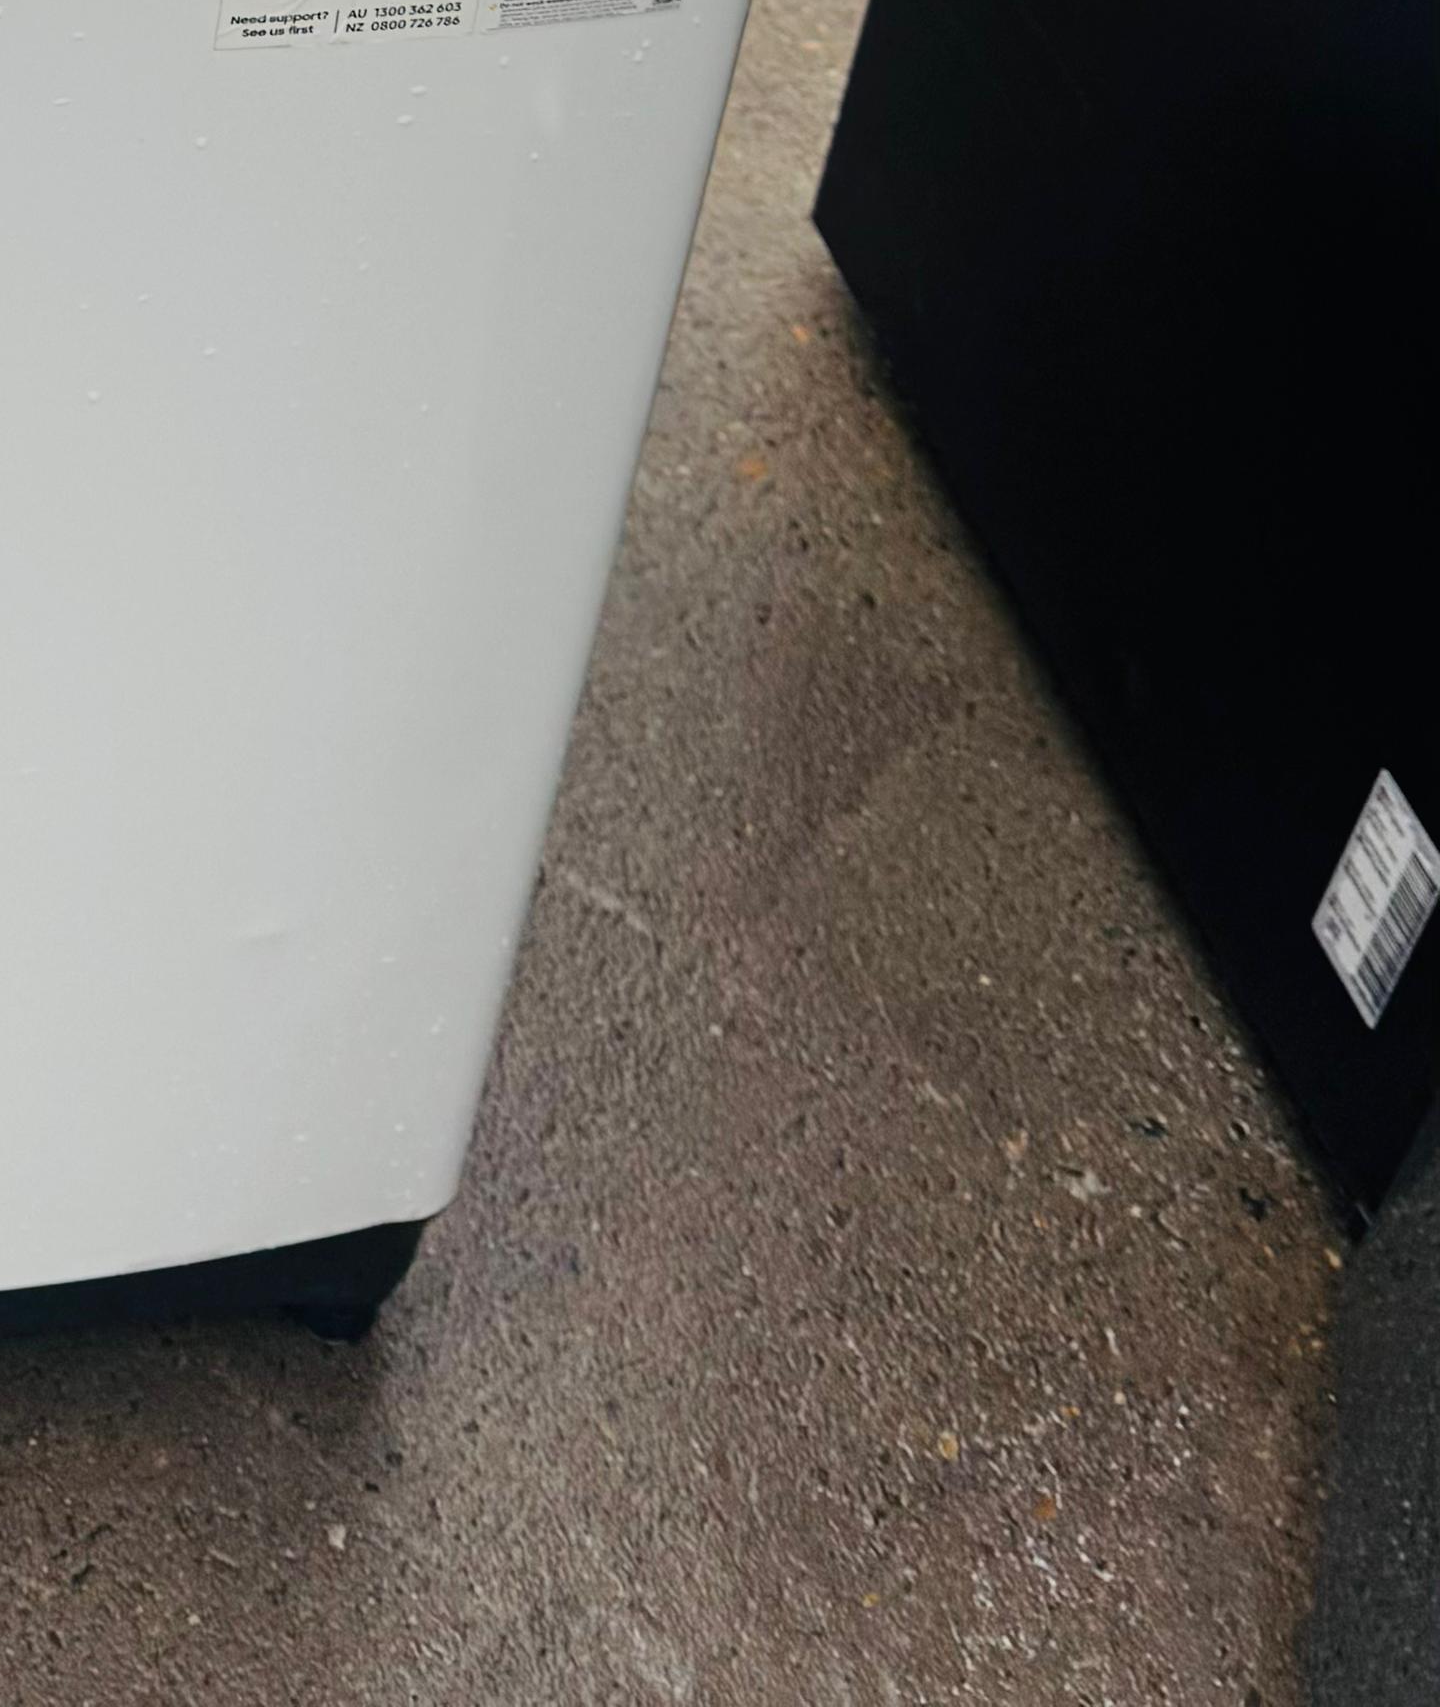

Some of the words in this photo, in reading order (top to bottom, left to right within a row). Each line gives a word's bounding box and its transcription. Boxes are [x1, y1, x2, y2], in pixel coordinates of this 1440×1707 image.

[230, 14, 267, 26] Need
[269, 11, 329, 26] support?
[347, 9, 367, 20] AU
[375, 6, 406, 18] 1300
[409, 3, 434, 15] 362
[436, 2, 462, 13] 603
[242, 28, 267, 38] See
[269, 27, 285, 36] us
[288, 25, 313, 35] first
[345, 23, 364, 33] NZ
[371, 19, 406, 32] 0800
[409, 18, 433, 29] 726
[436, 16, 460, 26] 786
